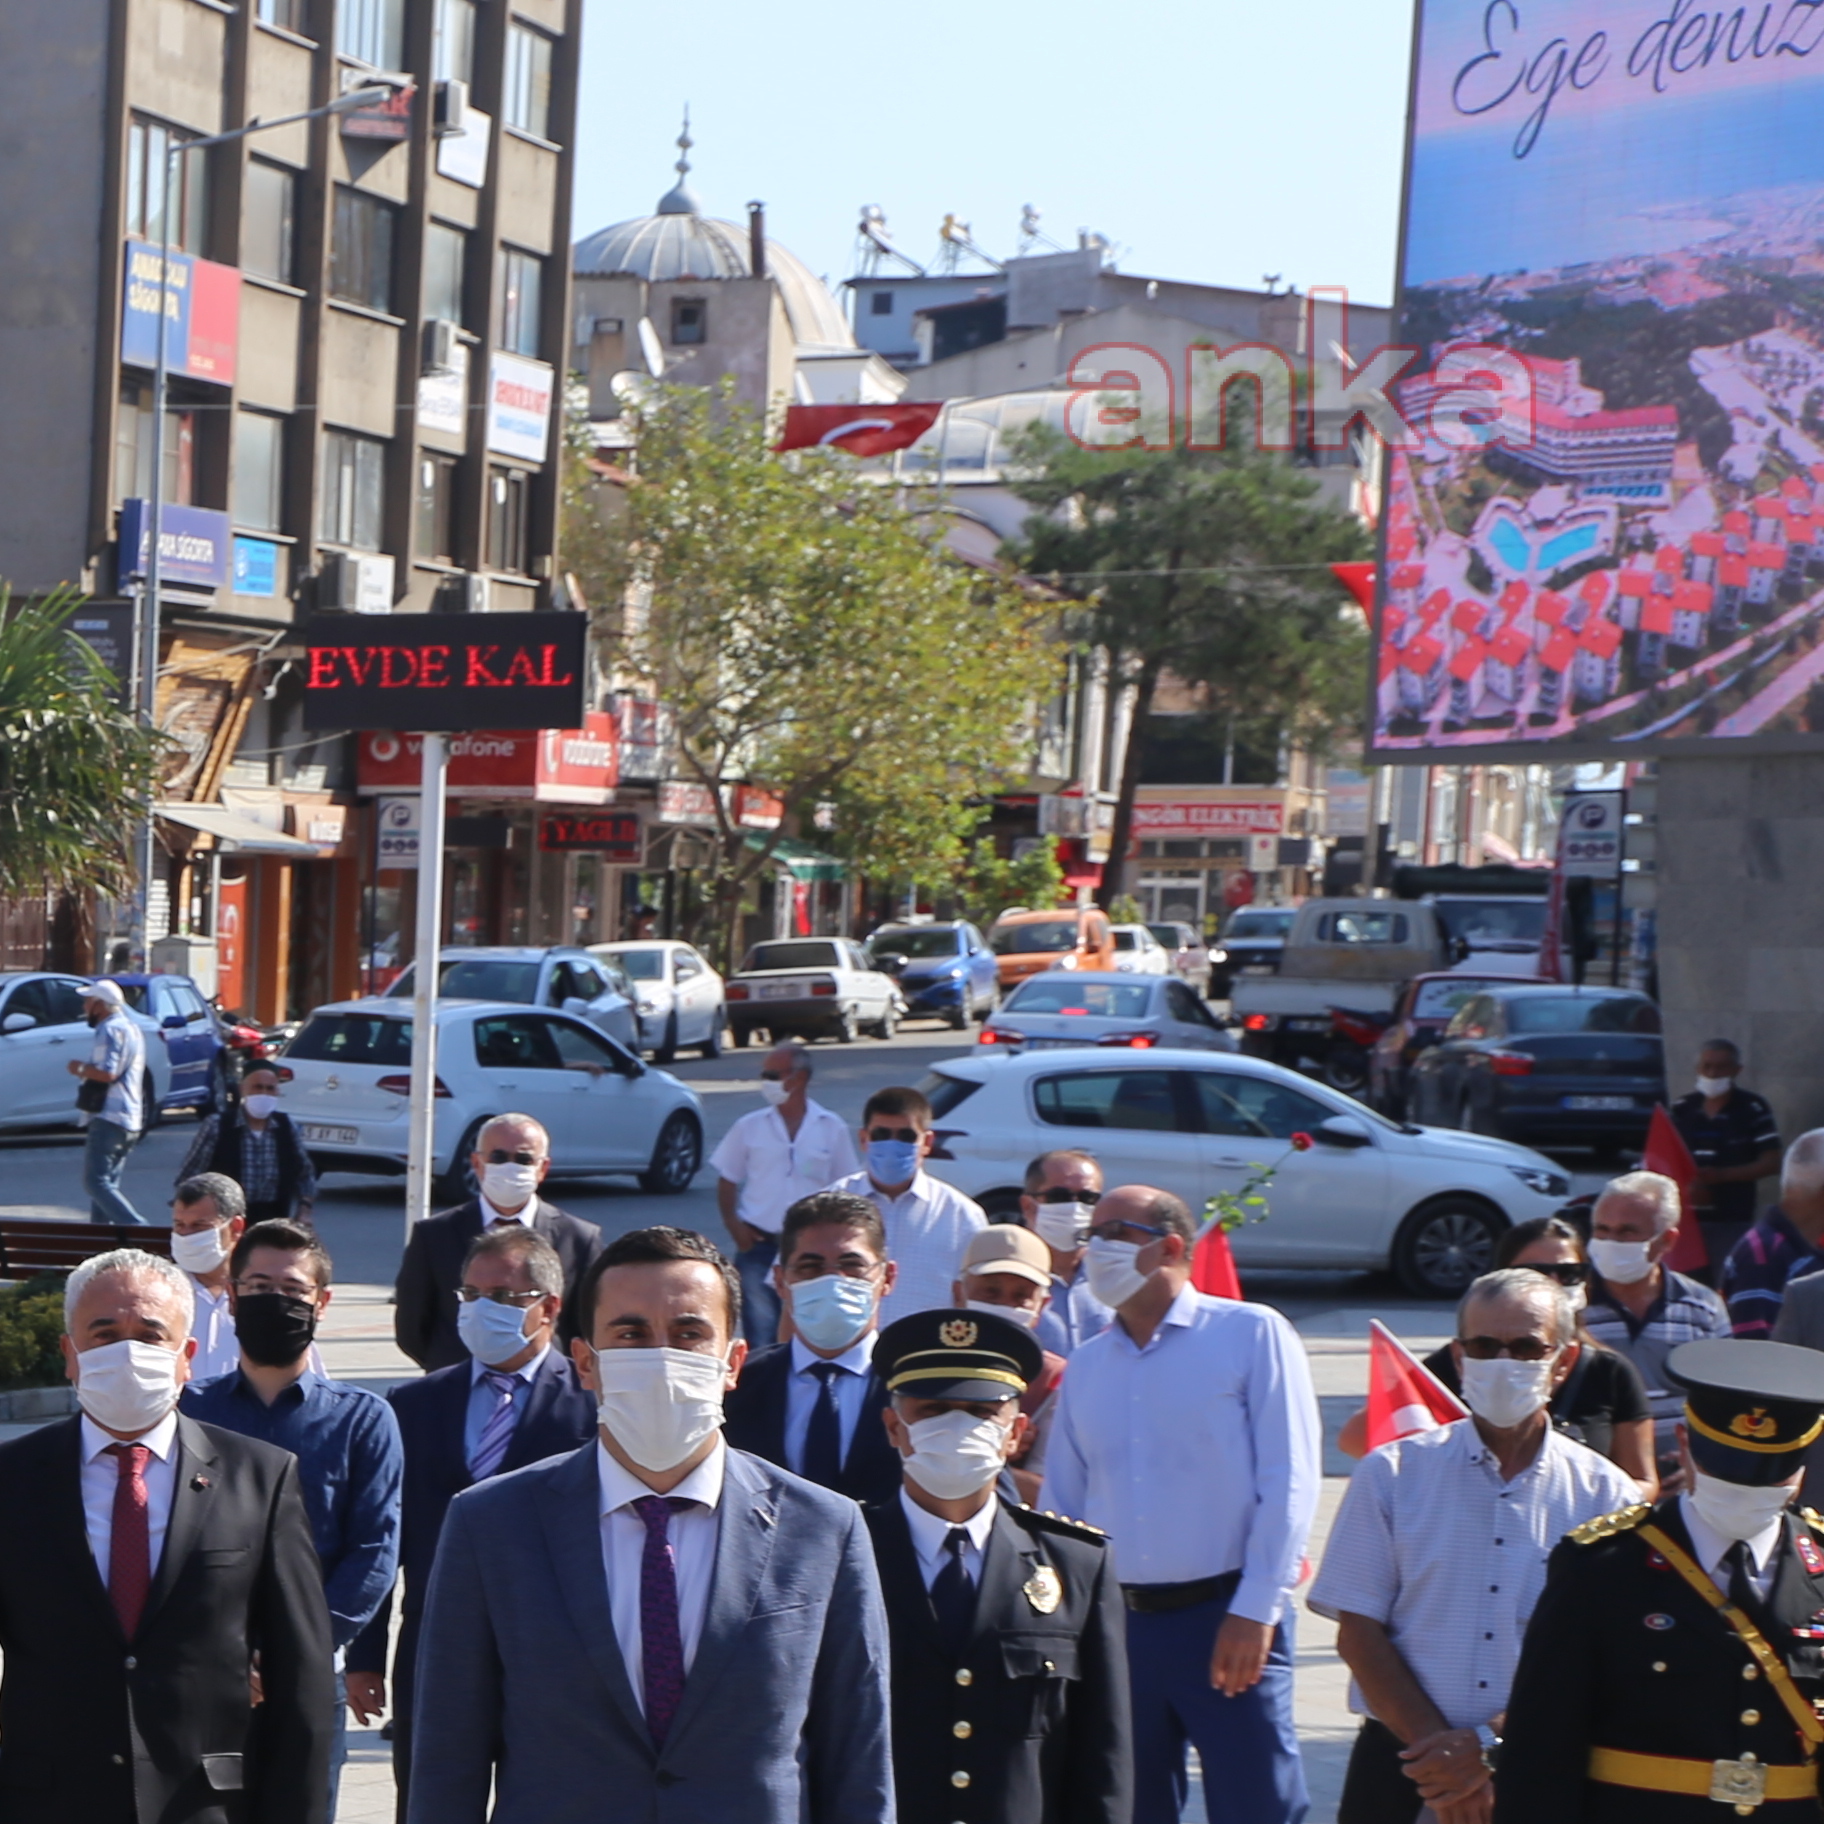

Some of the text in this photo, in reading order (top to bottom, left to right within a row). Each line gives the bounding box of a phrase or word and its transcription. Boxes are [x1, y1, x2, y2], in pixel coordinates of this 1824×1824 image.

[1452, 0, 1611, 159] Ege
[305, 643, 574, 689] EVDE KAL
